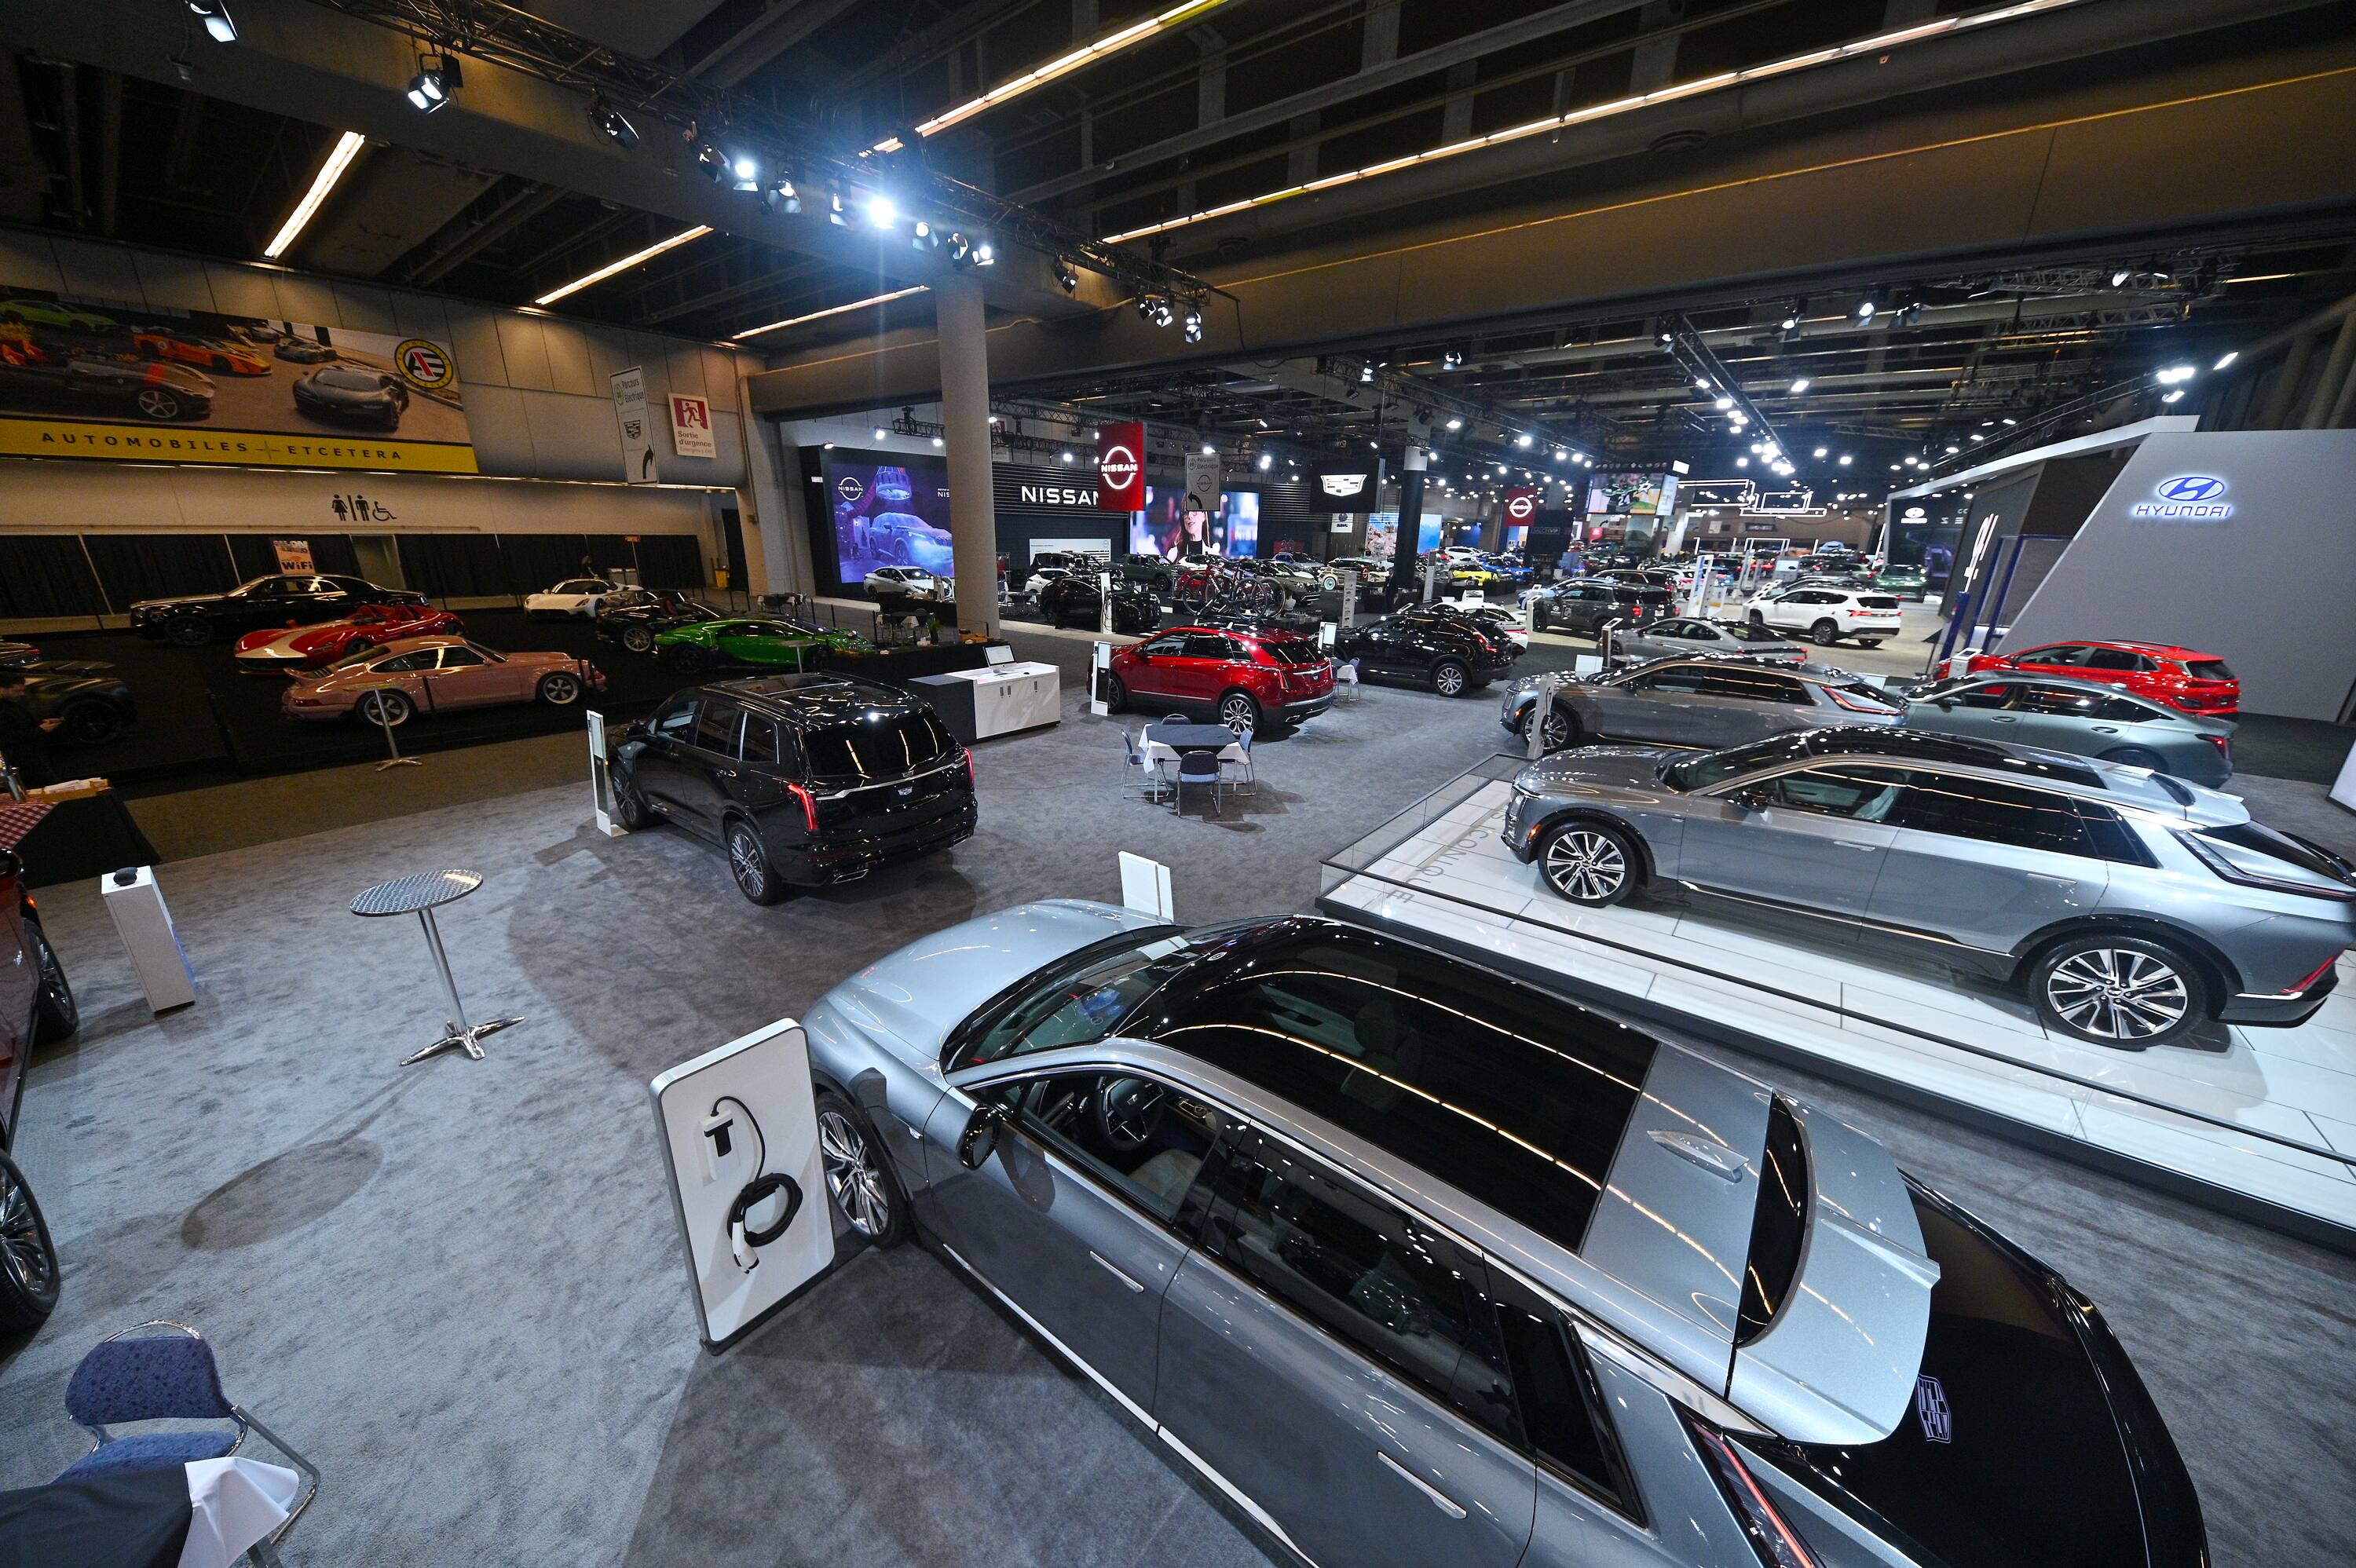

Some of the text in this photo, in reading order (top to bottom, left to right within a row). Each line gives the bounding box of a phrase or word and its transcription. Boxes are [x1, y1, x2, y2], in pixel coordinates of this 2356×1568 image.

[42, 433, 401, 459] AUTOMOBILES ETCETERA
[679, 439, 712, 448] d'urgence
[1101, 464, 1138, 473] NISSAN
[1618, 495, 1630, 506] 24
[2136, 505, 2230, 517] HYUNDAI
[281, 561, 313, 569] WiFi
